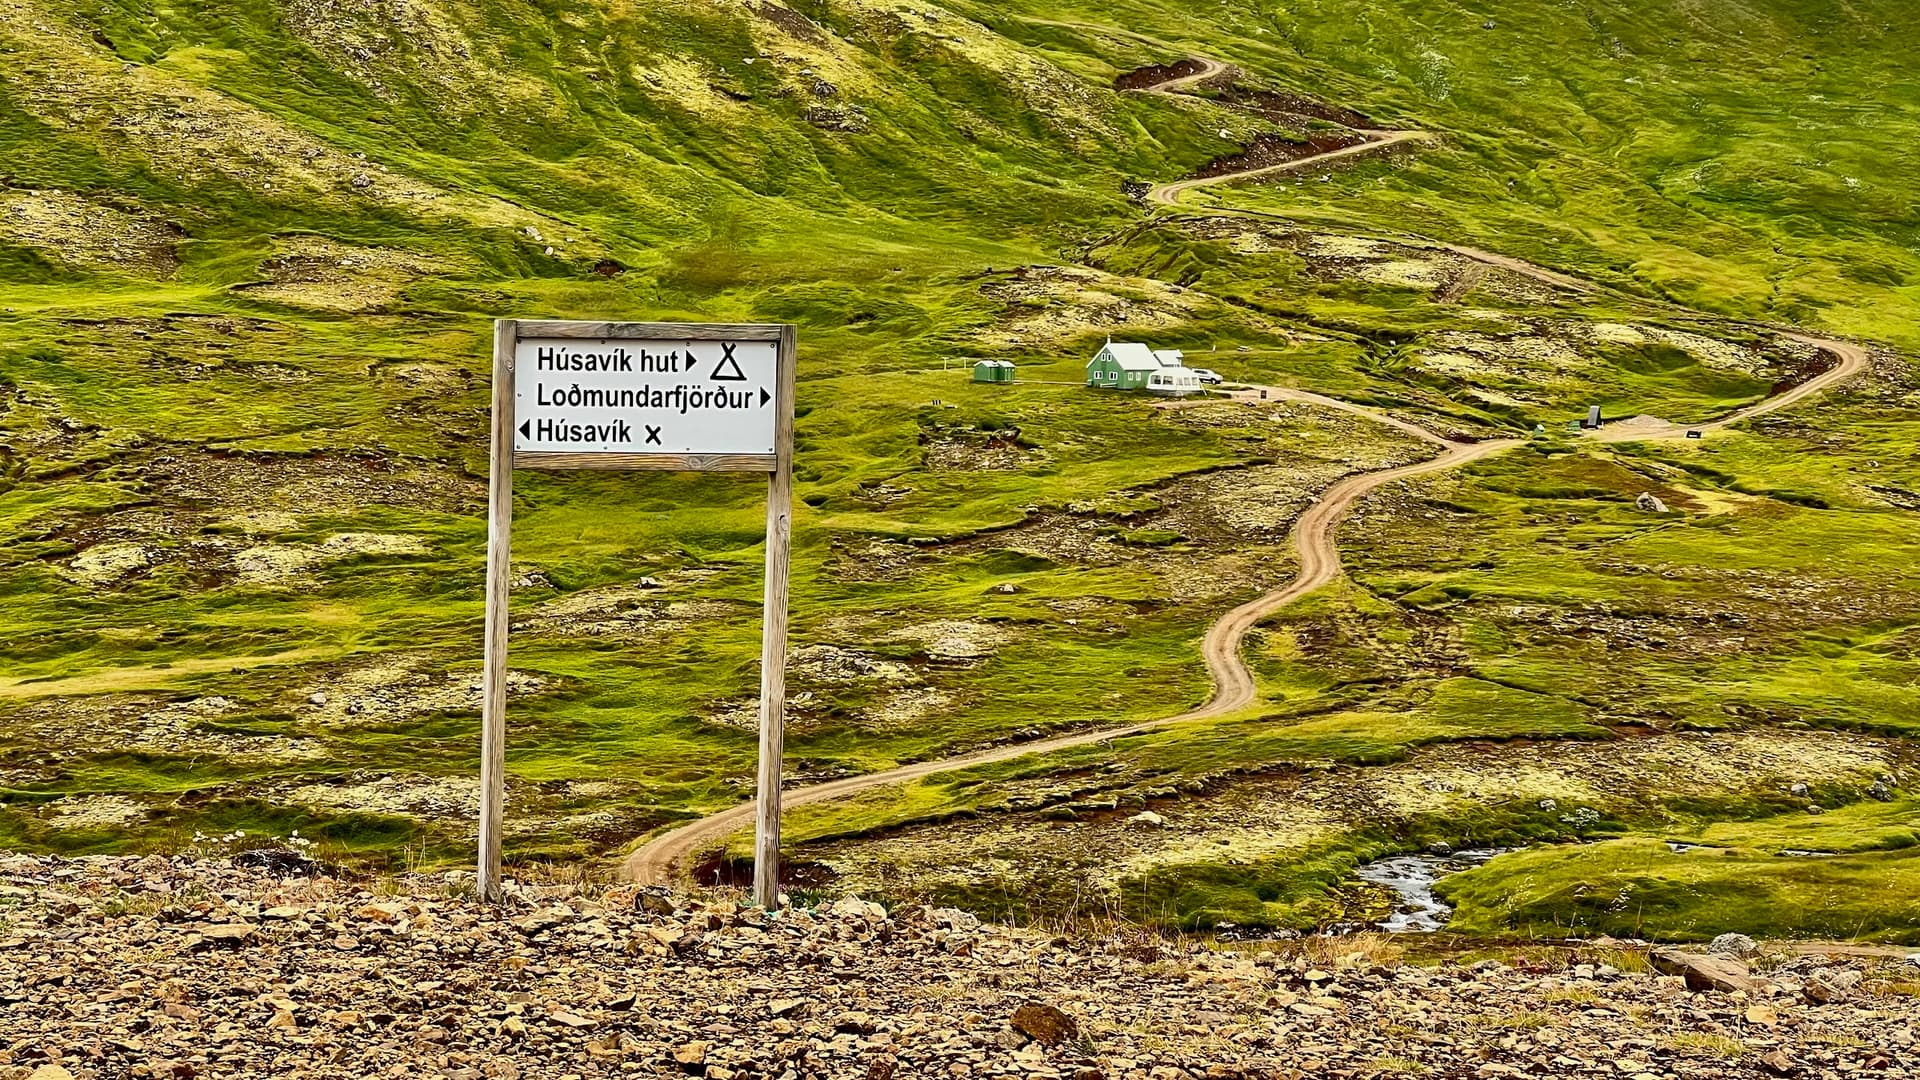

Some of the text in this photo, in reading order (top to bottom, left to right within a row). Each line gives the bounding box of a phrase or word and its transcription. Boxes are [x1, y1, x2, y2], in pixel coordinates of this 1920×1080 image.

[538, 347, 679, 373] Húsavík hut
[537, 383, 754, 415] Loðmundarfjörður
[537, 418, 632, 443] Húsavík
